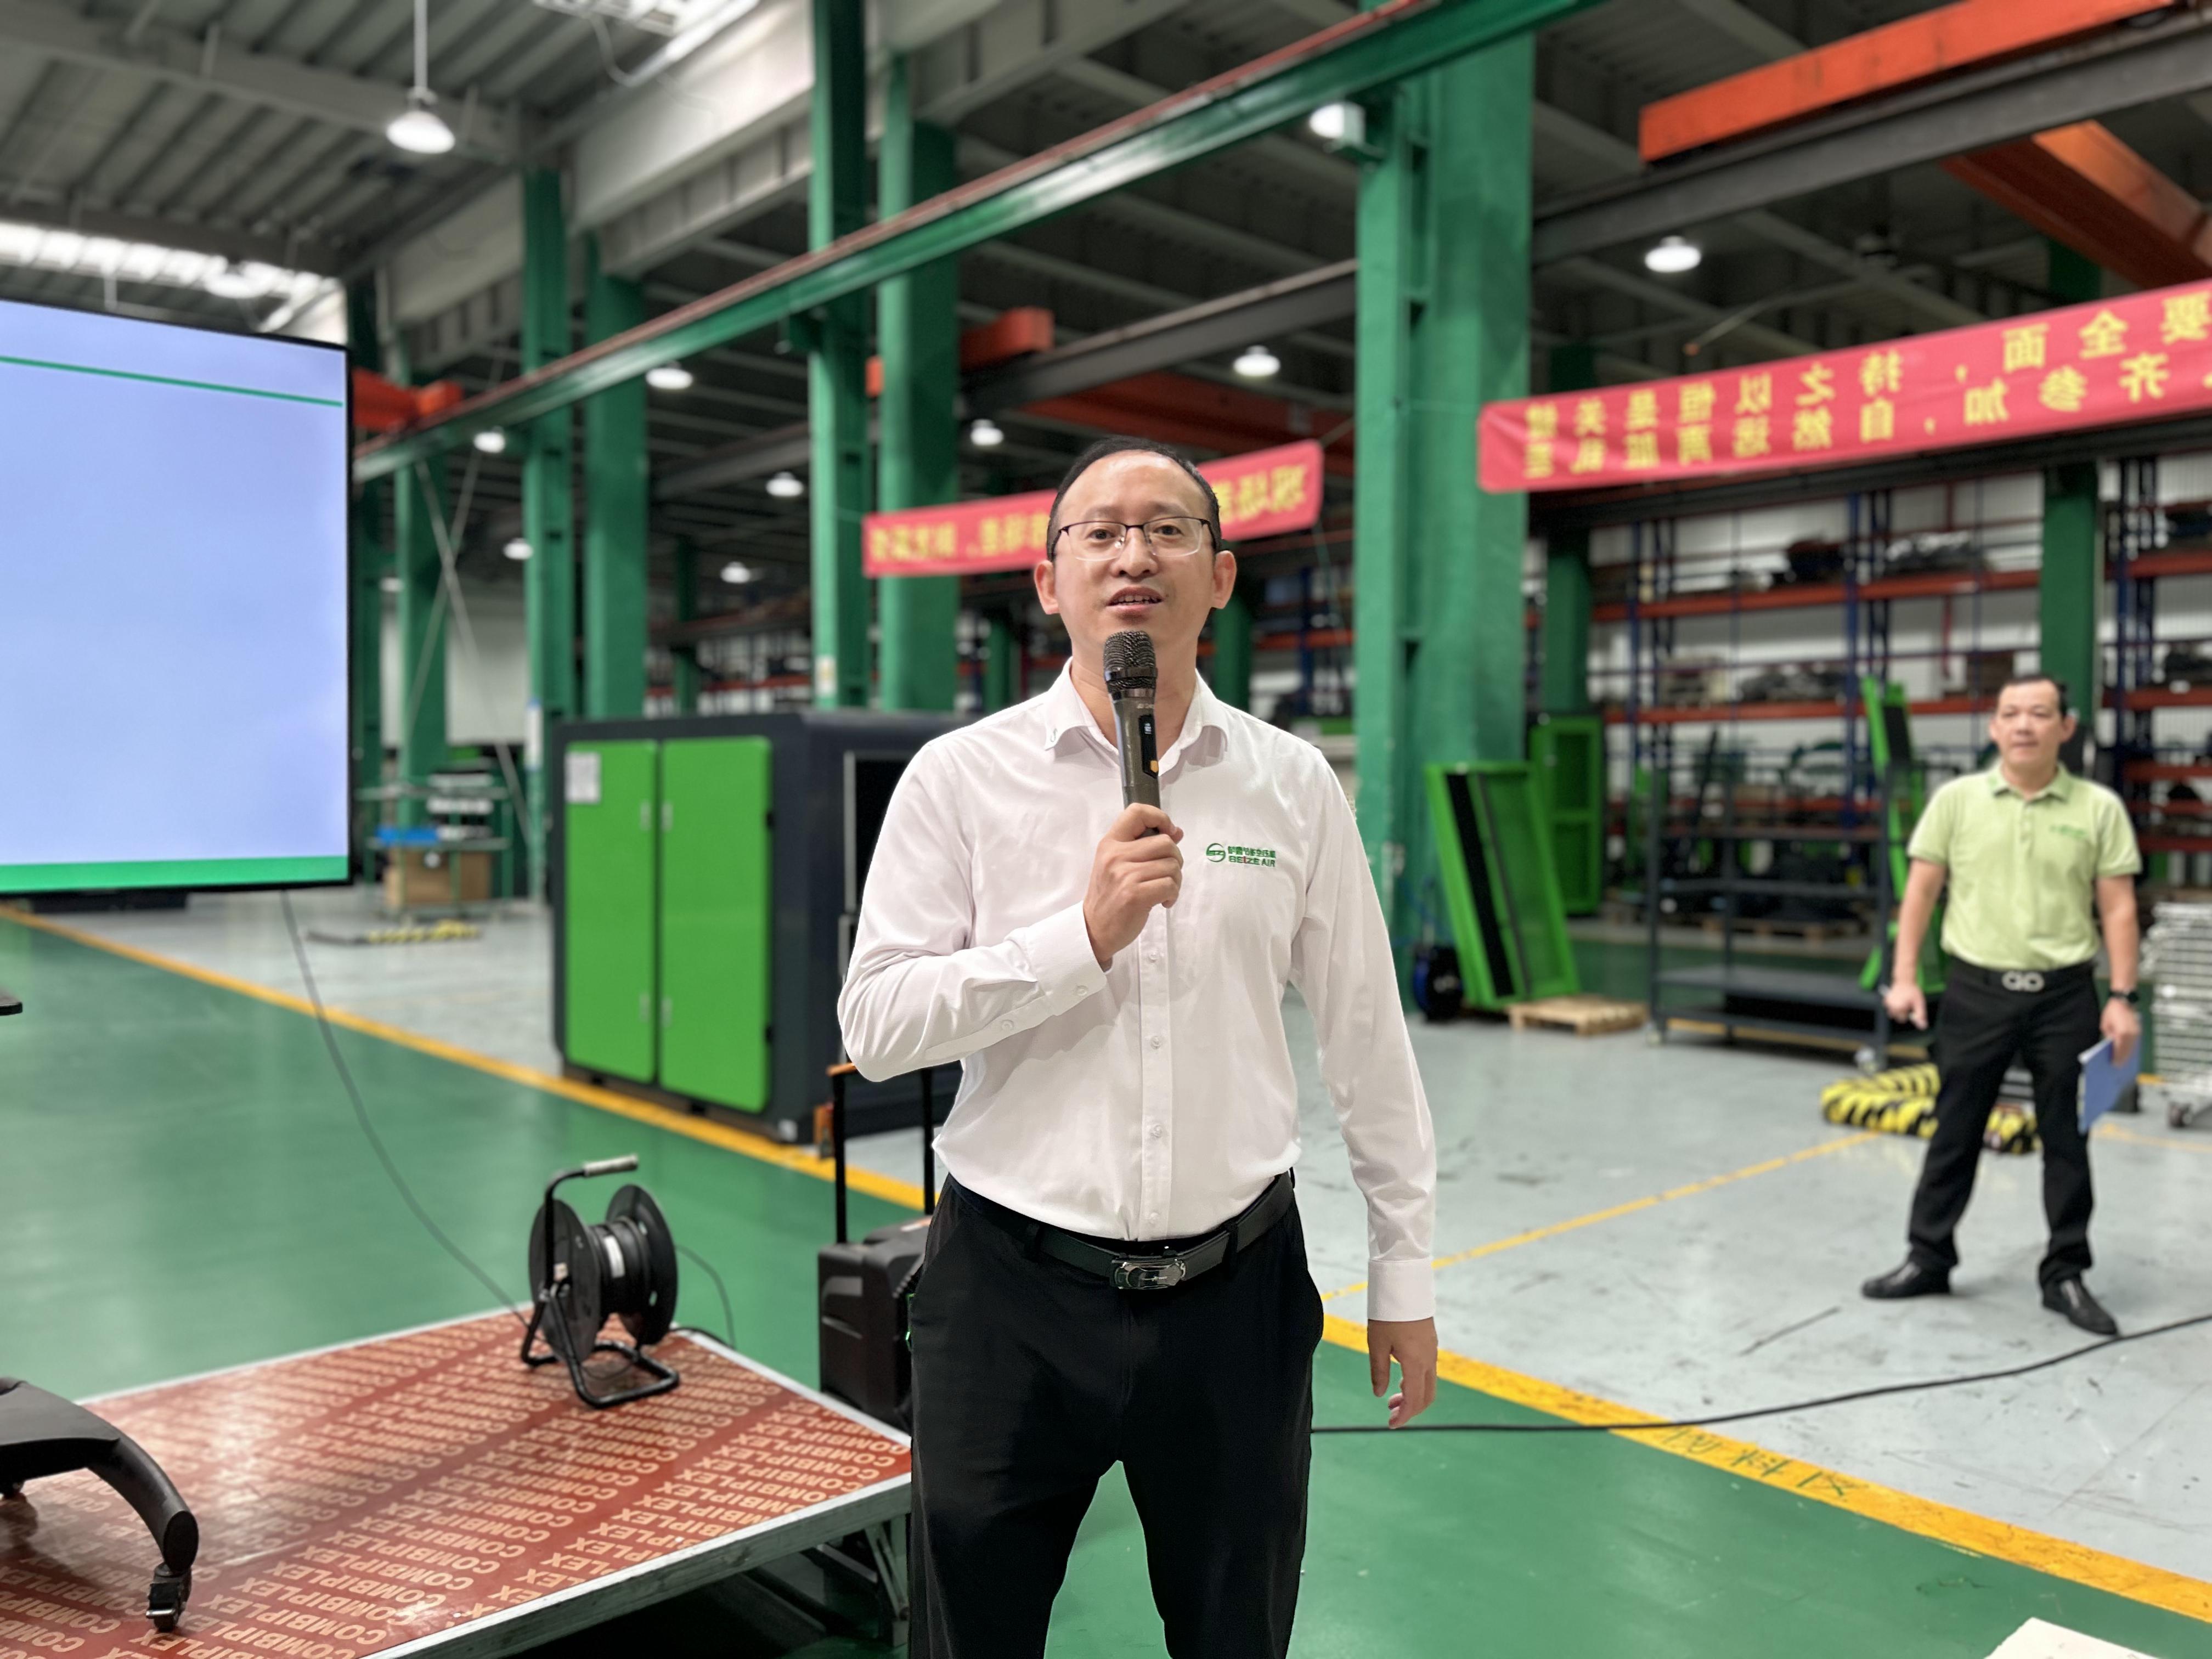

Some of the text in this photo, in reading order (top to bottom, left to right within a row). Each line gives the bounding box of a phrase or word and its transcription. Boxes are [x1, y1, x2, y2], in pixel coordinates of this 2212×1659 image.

[1261, 858, 1276, 867] AIR
[518, 1428, 679, 1462] COMBIPLEX
[540, 1418, 698, 1449] COMBIPLEX
[729, 1434, 896, 1467] COMBIPLEX
[475, 1451, 640, 1486] COMBIPLEX
[497, 1440, 659, 1474] COMBIPLEX
[692, 1457, 863, 1493] COMBIPLEX
[710, 1445, 879, 1480] COMBIPLEX
[427, 1475, 597, 1513] COMBIPLEX
[451, 1463, 619, 1499] COMBIPLEX
[376, 1502, 551, 1542] COMBIPLEX
[402, 1488, 574, 1527] COMBIPLEX
[320, 1530, 501, 1574] COMBIPLEX
[348, 1516, 527, 1558] COMBIPLEX
[260, 1561, 448, 1608] COMBIPLEX
[291, 1545, 475, 1590] COMBIPLEX
[195, 1594, 389, 1645] COMBIPLEX
[228, 1577, 419, 1626] COMBIPLEX
